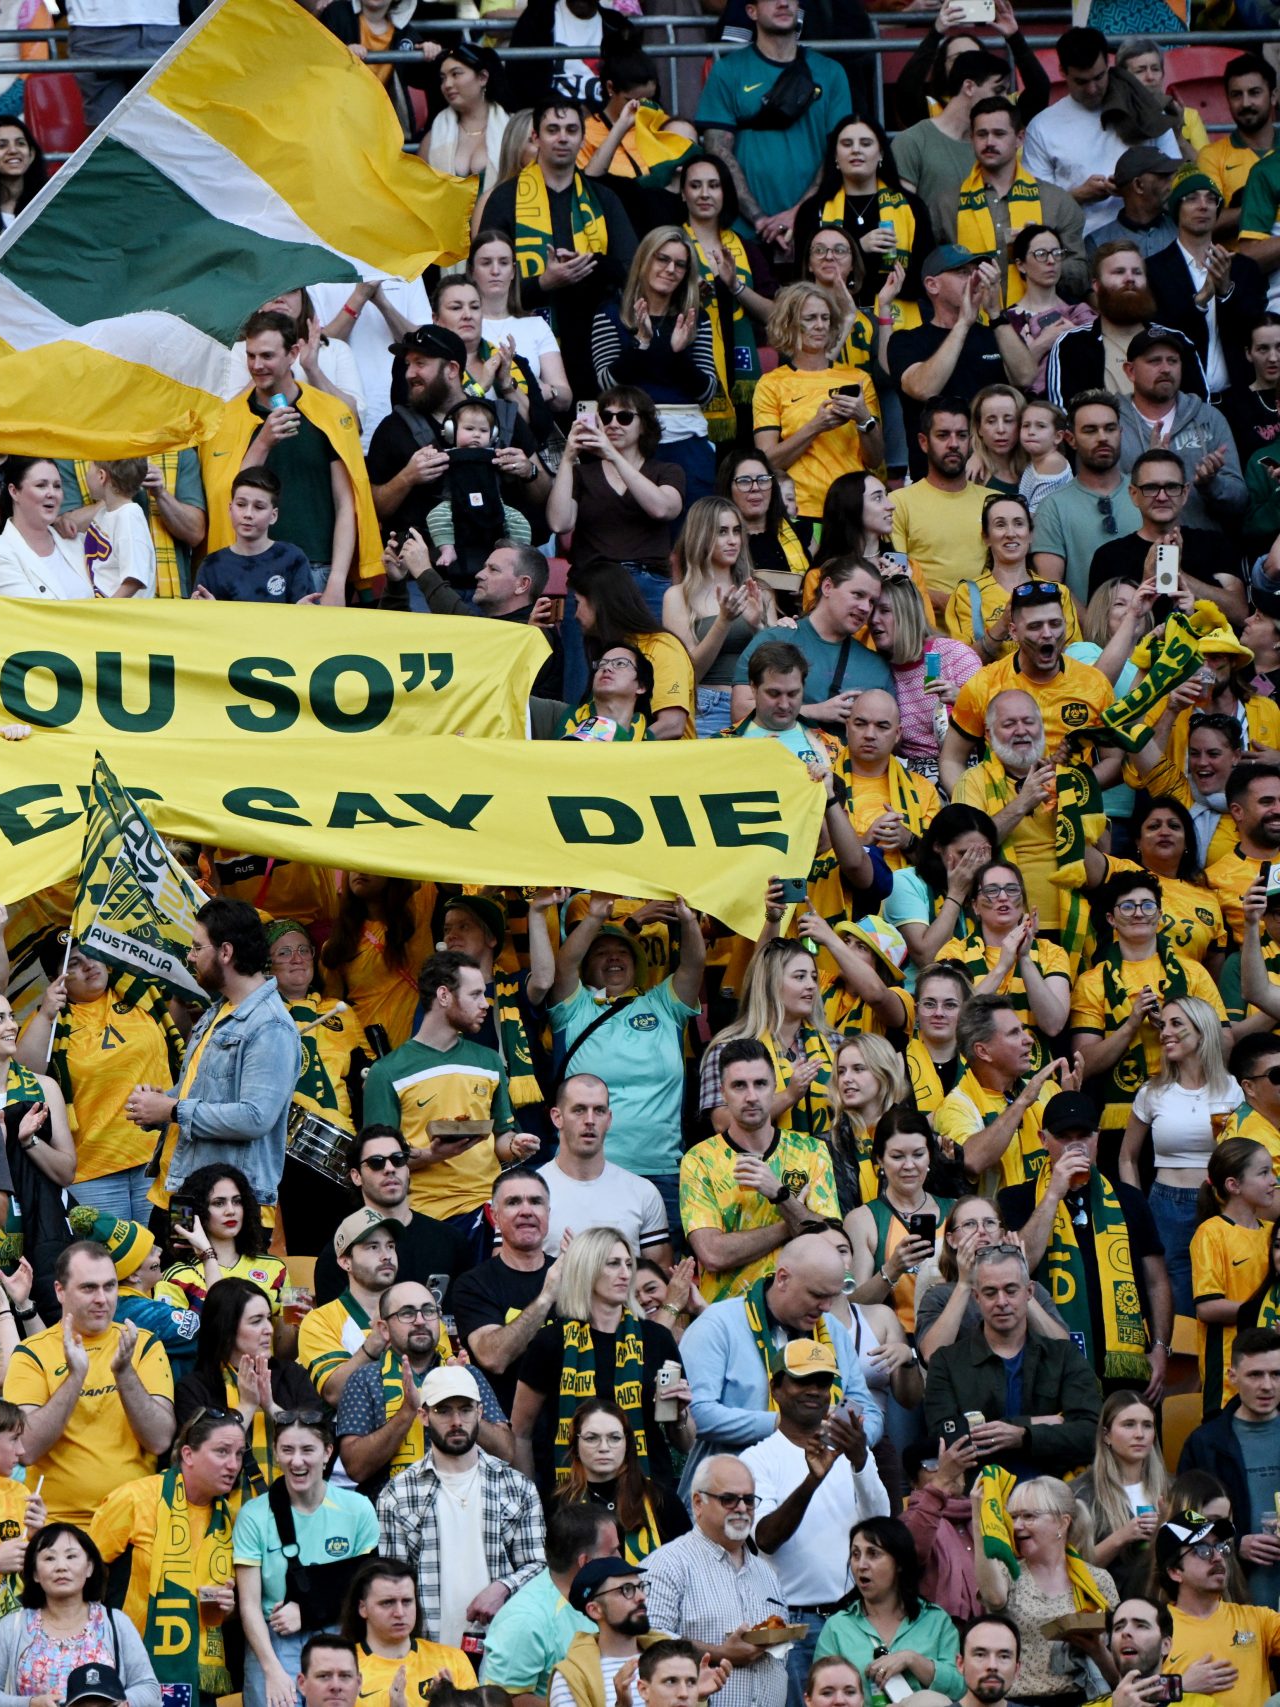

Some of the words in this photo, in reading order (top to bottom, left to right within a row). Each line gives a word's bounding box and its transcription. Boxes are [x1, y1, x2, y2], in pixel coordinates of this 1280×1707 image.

[222, 787, 493, 831] SAY
[548, 791, 788, 855] DIE
[234, 864, 255, 874] AUS
[90, 927, 173, 973] AUSTRALIA
[179, 1310, 194, 1336] SEVEN
